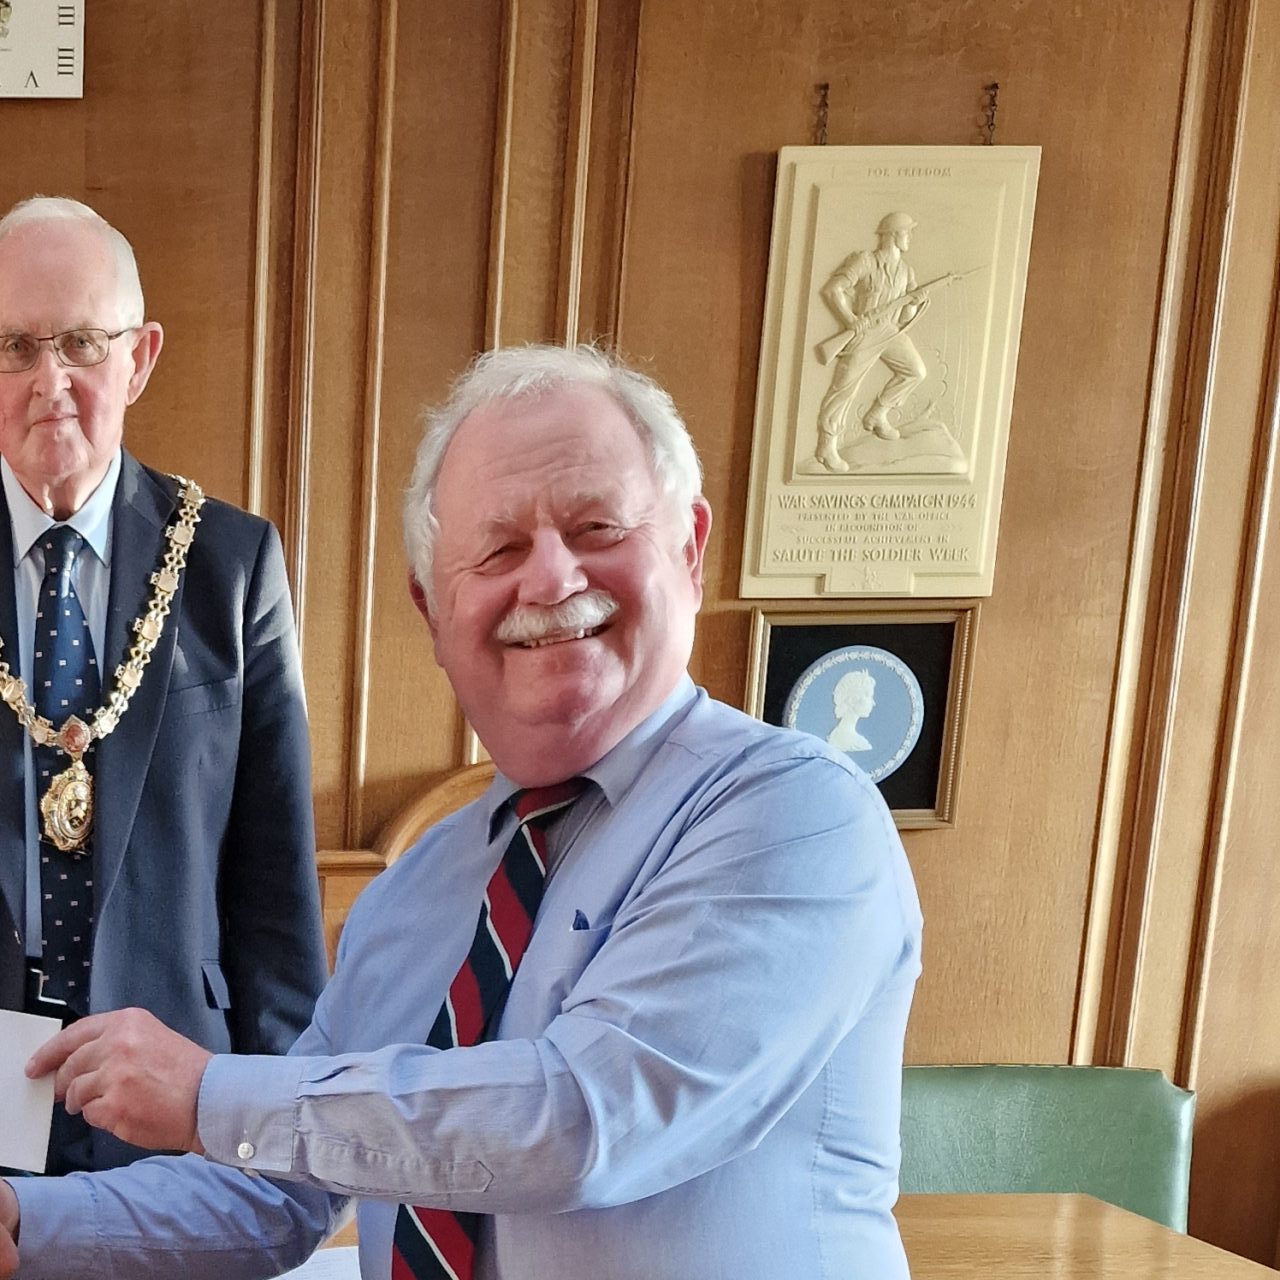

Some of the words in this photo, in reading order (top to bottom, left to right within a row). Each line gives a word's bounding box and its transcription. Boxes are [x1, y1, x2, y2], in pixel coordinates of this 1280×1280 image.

[58, 6, 75, 26] III
[58, 48, 75, 76] IIII
[24, 70, 40, 88] V
[778, 494, 807, 509] WAR
[810, 494, 867, 509] SAVINGS
[870, 494, 944, 509] CAMPAIGN
[947, 494, 977, 509] 1944
[863, 535, 932, 545] ACHIEVEMENT
[772, 549, 825, 562] SALUTE
[830, 549, 857, 562] THE
[862, 549, 922, 562] SOLDIER
[929, 548, 970, 562] WEEK
